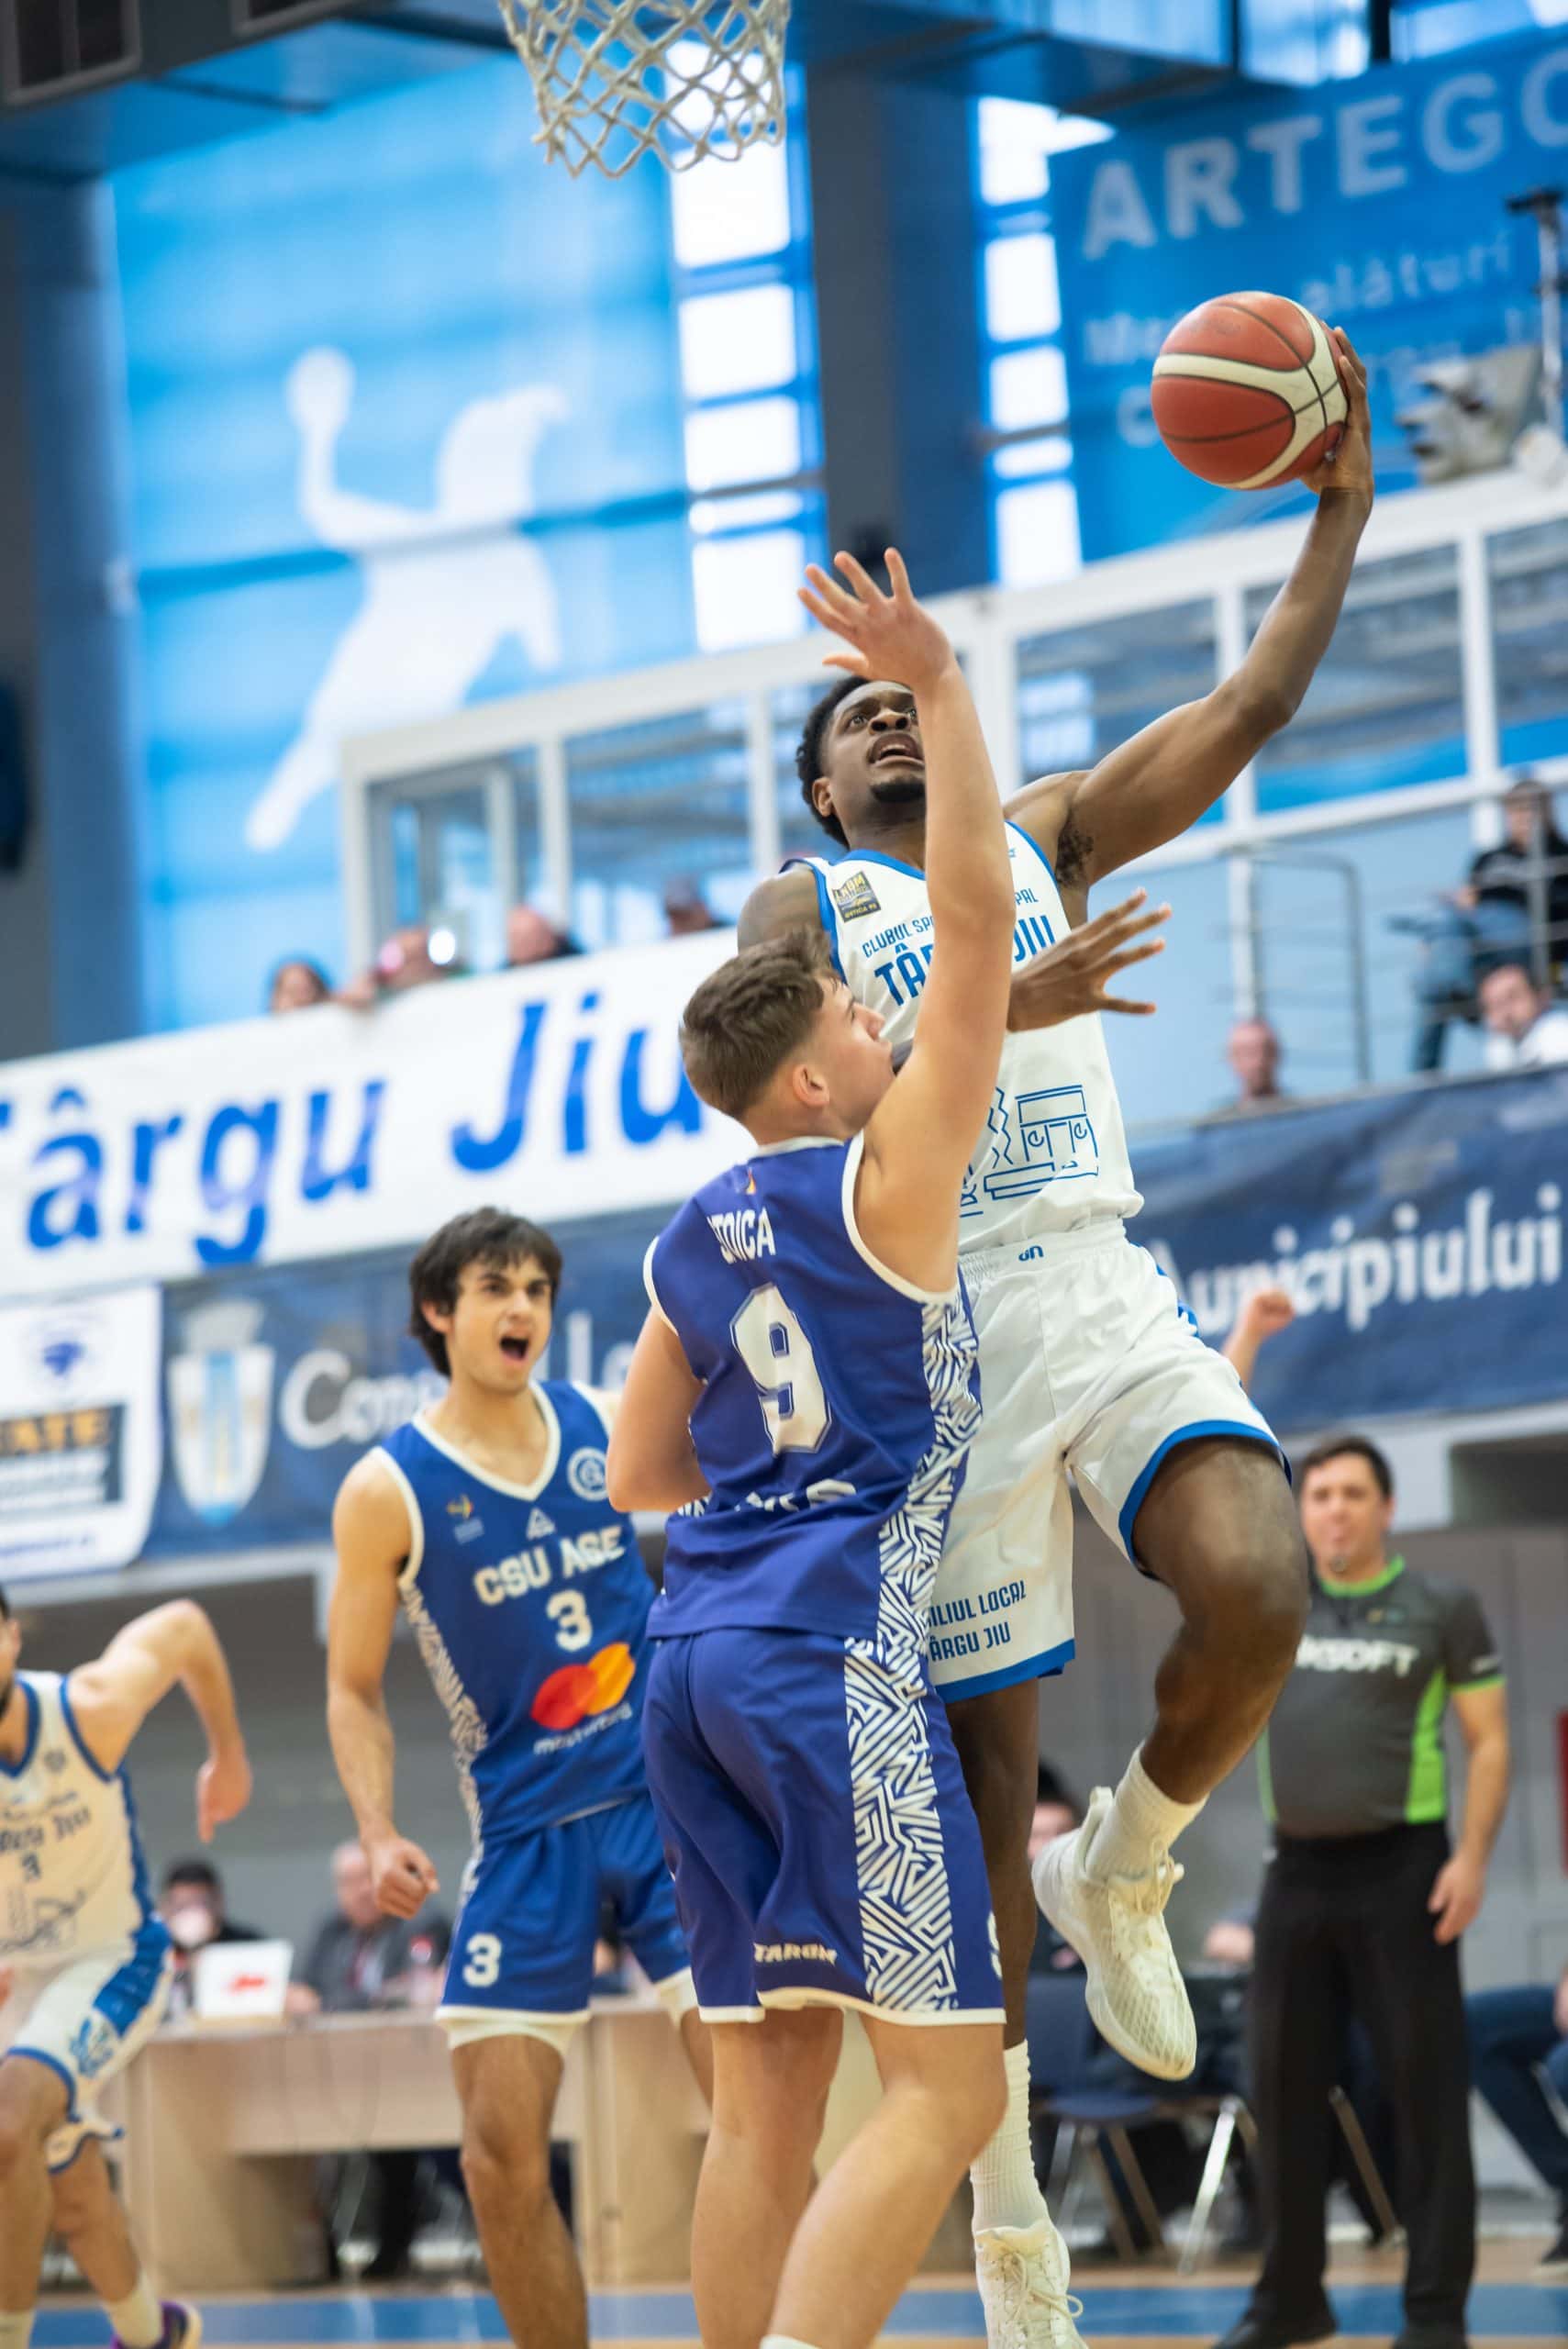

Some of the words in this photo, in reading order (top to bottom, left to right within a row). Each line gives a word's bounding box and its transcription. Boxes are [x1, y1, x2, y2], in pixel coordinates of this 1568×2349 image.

[862, 923, 913, 958] CLUBUL
[0, 1088, 386, 1268] ârgu
[450, 991, 703, 1173] Jiu
[729, 1283, 832, 1457] 9
[474, 1546, 551, 1605] CSU
[929, 1598, 977, 1628] ILIUL
[978, 1580, 1027, 1615] LOCAL
[547, 1588, 593, 1651] 3
[929, 1631, 981, 1662] ÂRGU
[984, 1621, 1011, 1650] JIU
[462, 1932, 503, 1988] 3
